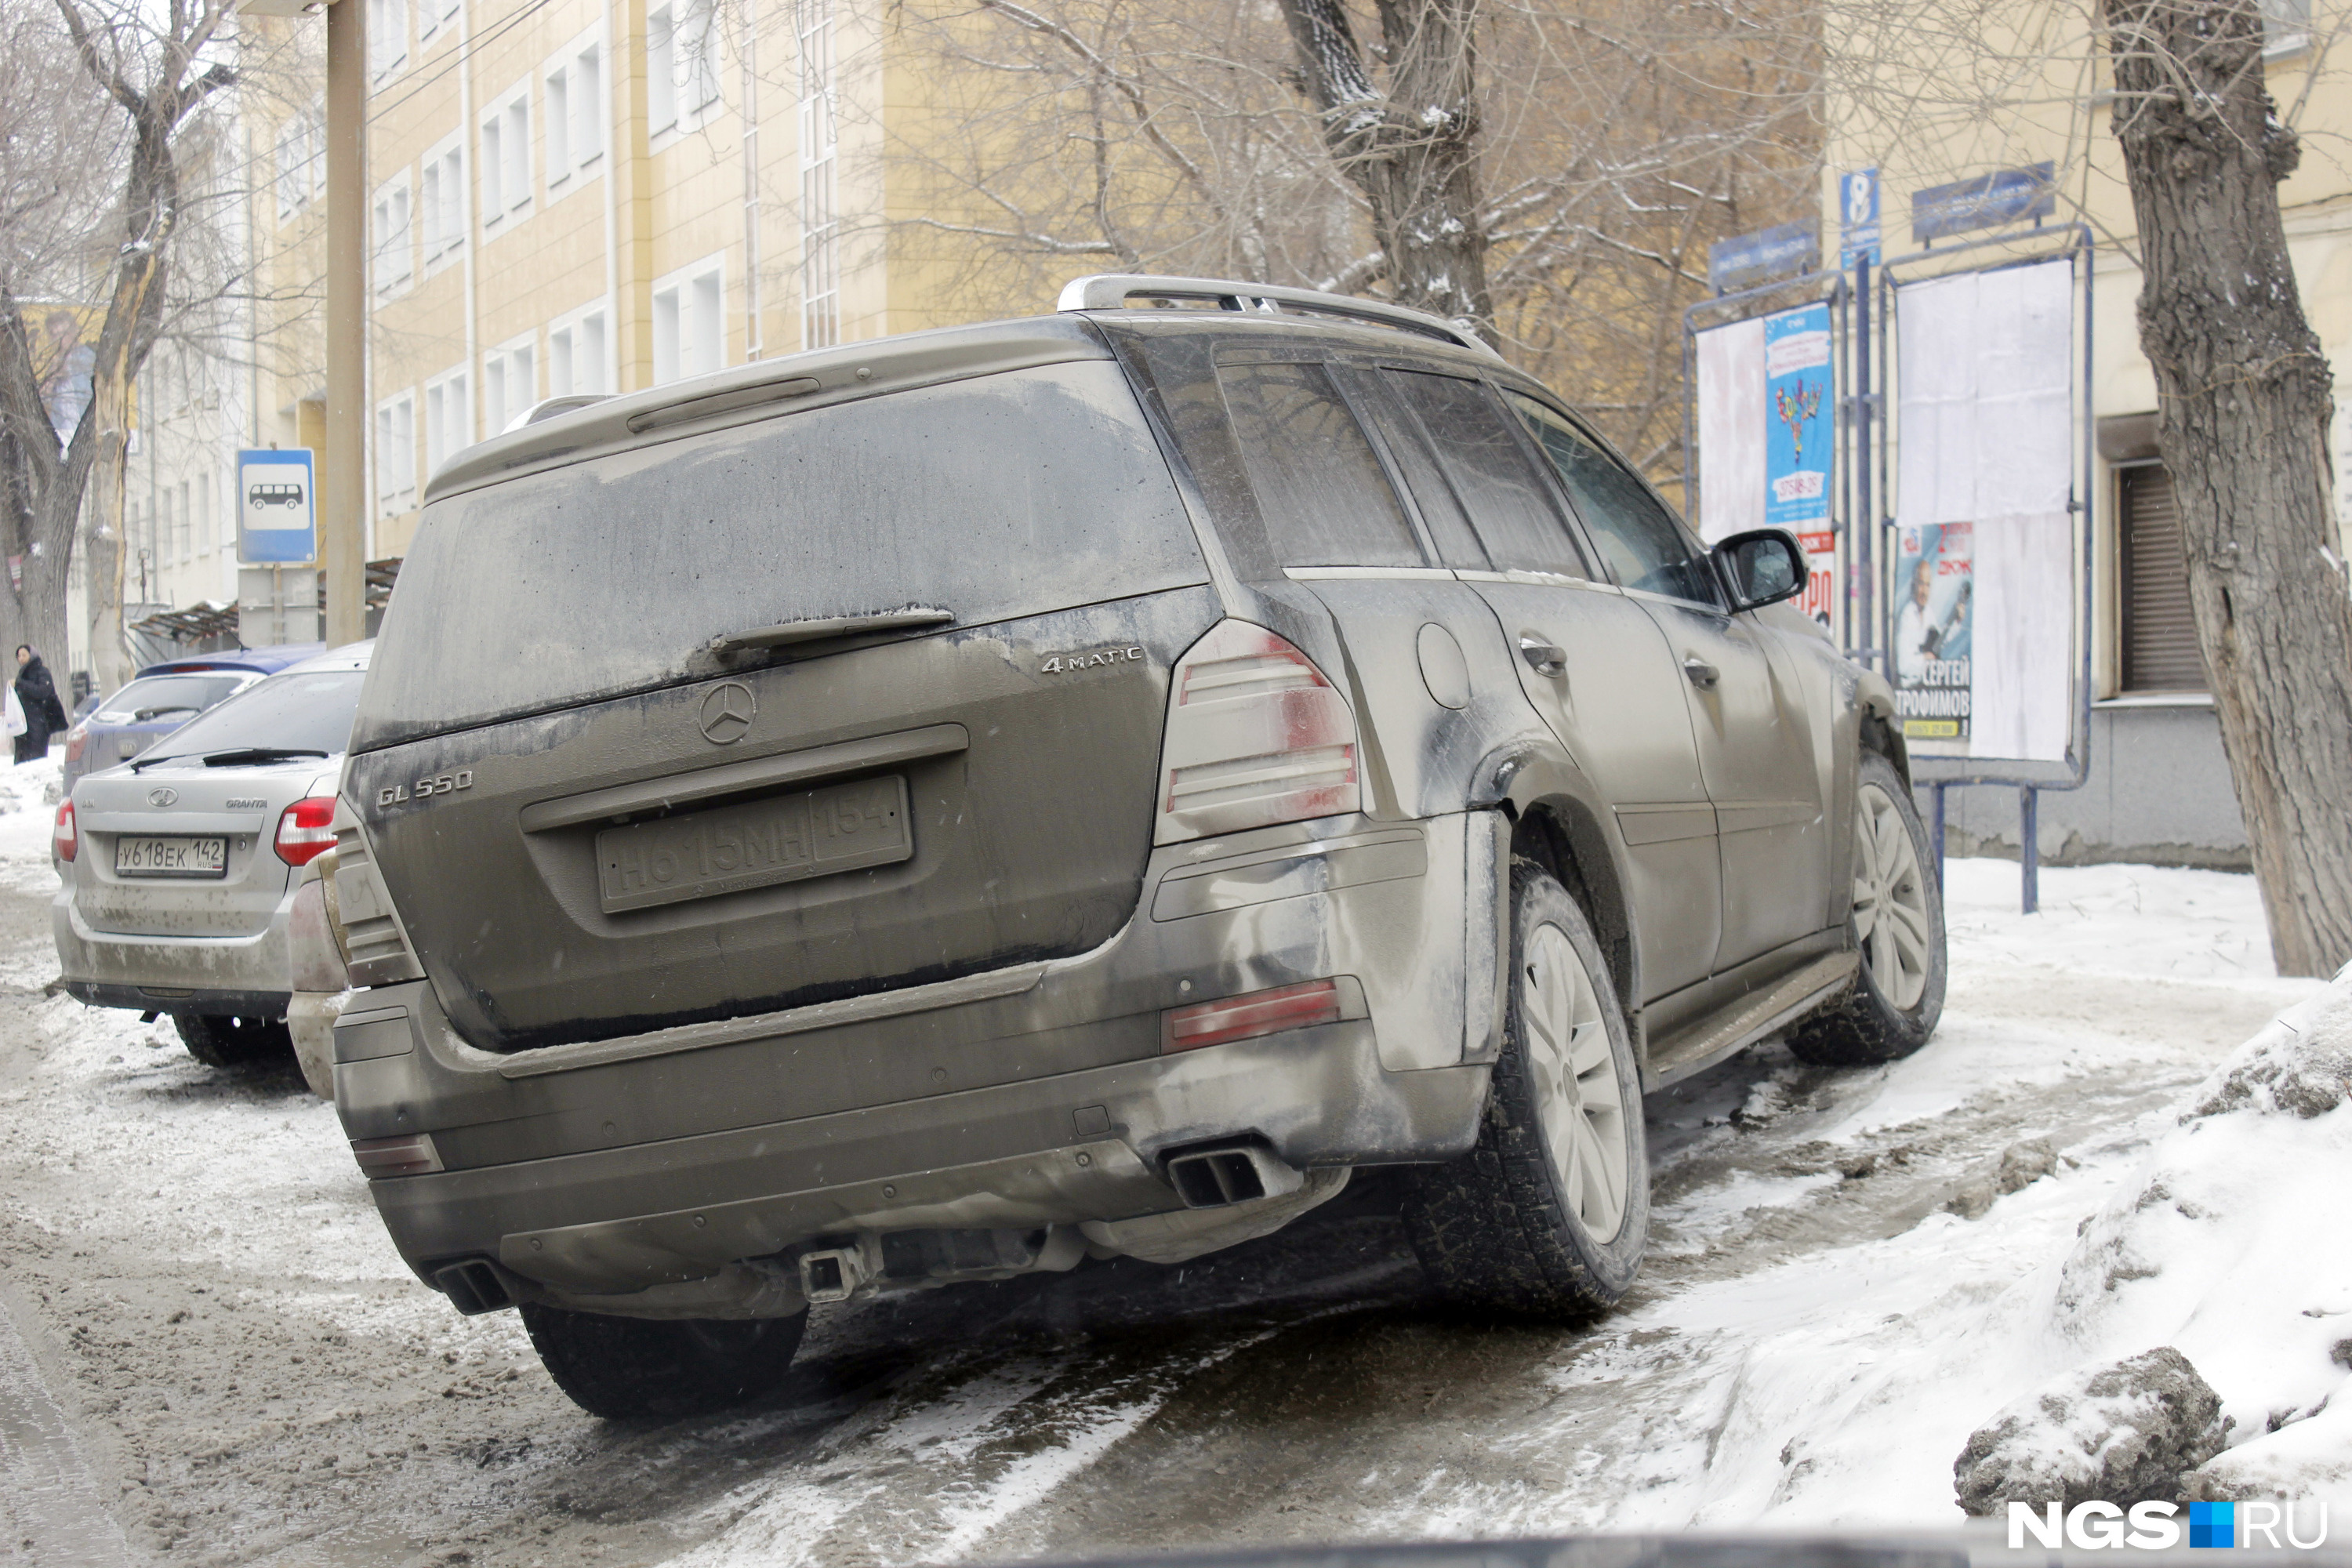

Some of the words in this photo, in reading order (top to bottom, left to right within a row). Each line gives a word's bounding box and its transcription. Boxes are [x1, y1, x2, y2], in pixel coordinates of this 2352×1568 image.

[1849, 172, 1871, 224] 8
[1041, 647, 1142, 673] 4MATIC
[1922, 655, 1969, 686] СЕРГЕЙ
[1895, 689, 1970, 717] ТРОФИМОВ
[226, 797, 267, 808] GRANTA
[377, 785, 408, 807] GL
[416, 771, 474, 798] 550
[193, 840, 220, 861] 142
